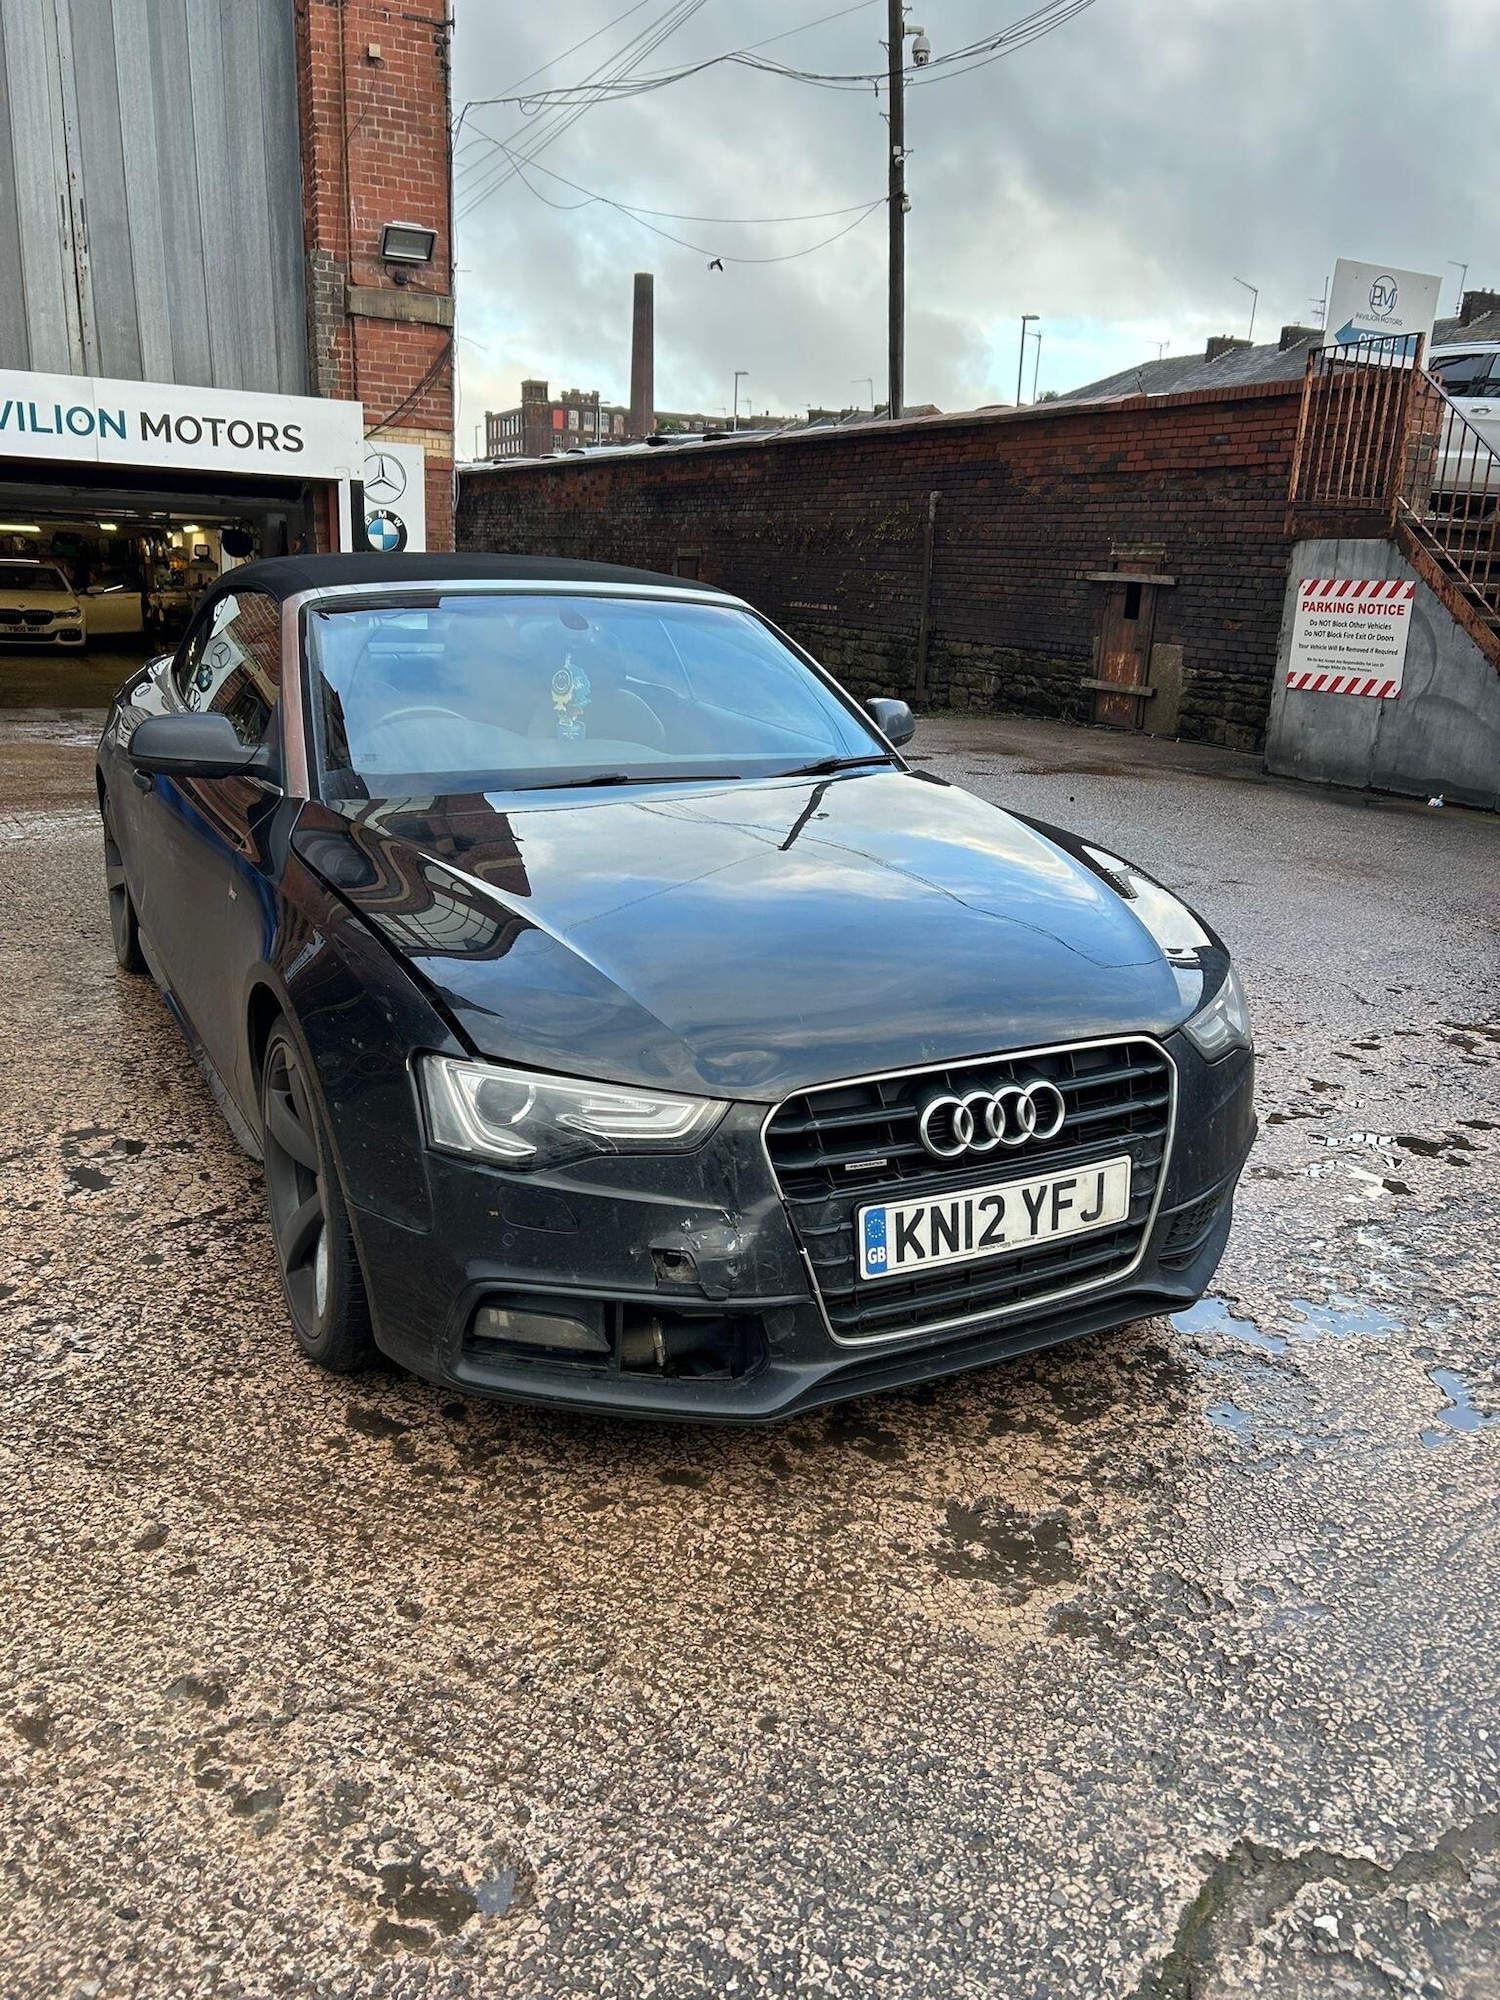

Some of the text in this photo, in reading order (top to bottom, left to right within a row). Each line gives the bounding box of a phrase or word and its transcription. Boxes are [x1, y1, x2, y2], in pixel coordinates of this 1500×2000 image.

[1355, 312, 1402, 326] PAVILION MOTORS
[140, 412, 304, 452] MOTORS
[365, 510, 403, 528] BMW
[1302, 602, 1405, 616] PARKING NOTICE
[1367, 622, 1392, 630] Vehicles
[895, 1172, 1104, 1263] KN12 YFJ
[867, 1246, 886, 1265] GB
